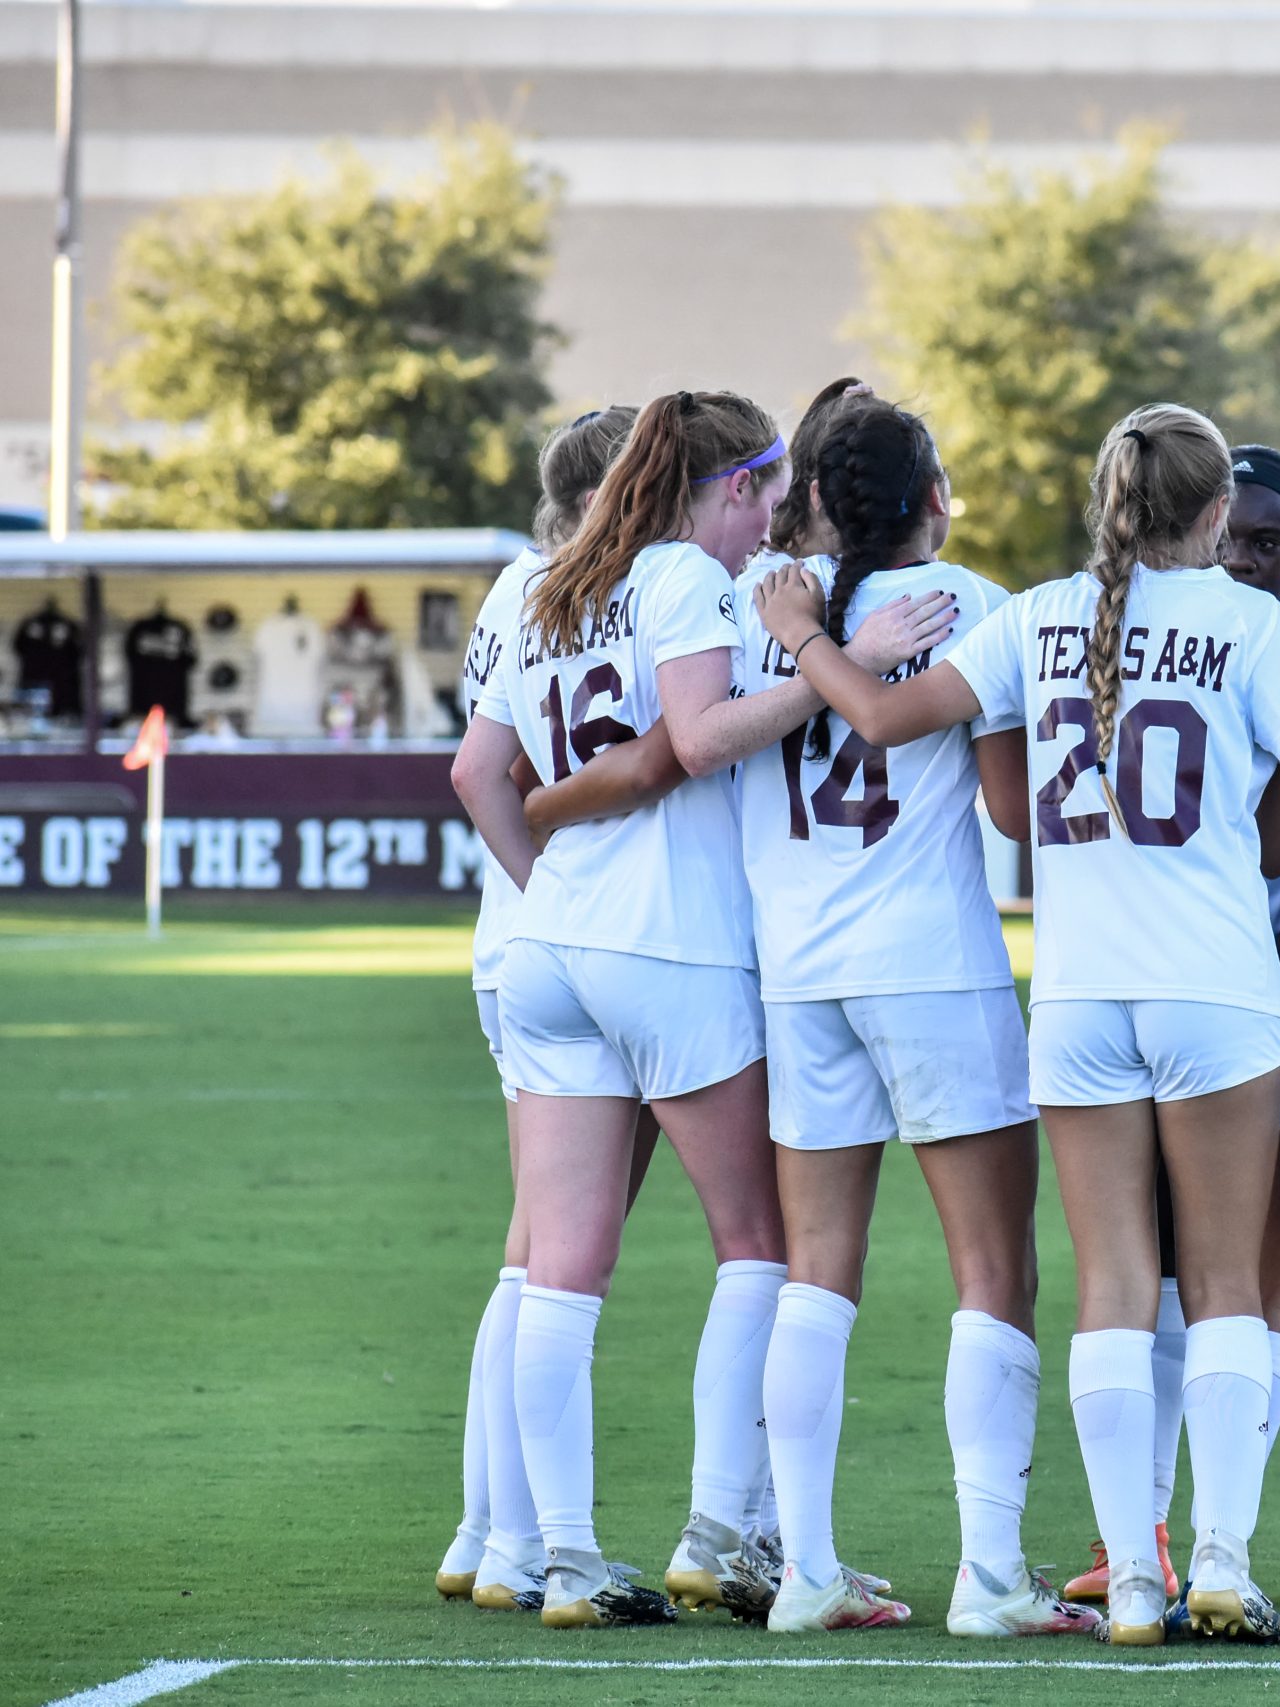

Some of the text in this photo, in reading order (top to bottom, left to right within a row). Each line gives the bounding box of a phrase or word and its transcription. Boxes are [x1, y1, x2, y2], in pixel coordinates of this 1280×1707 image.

[1038, 625, 1233, 692] TEXS A&M
[540, 662, 638, 783] 16
[1037, 697, 1207, 847] 20
[781, 722, 899, 849] 14
[42, 816, 128, 887] OF
[142, 818, 282, 889] THE
